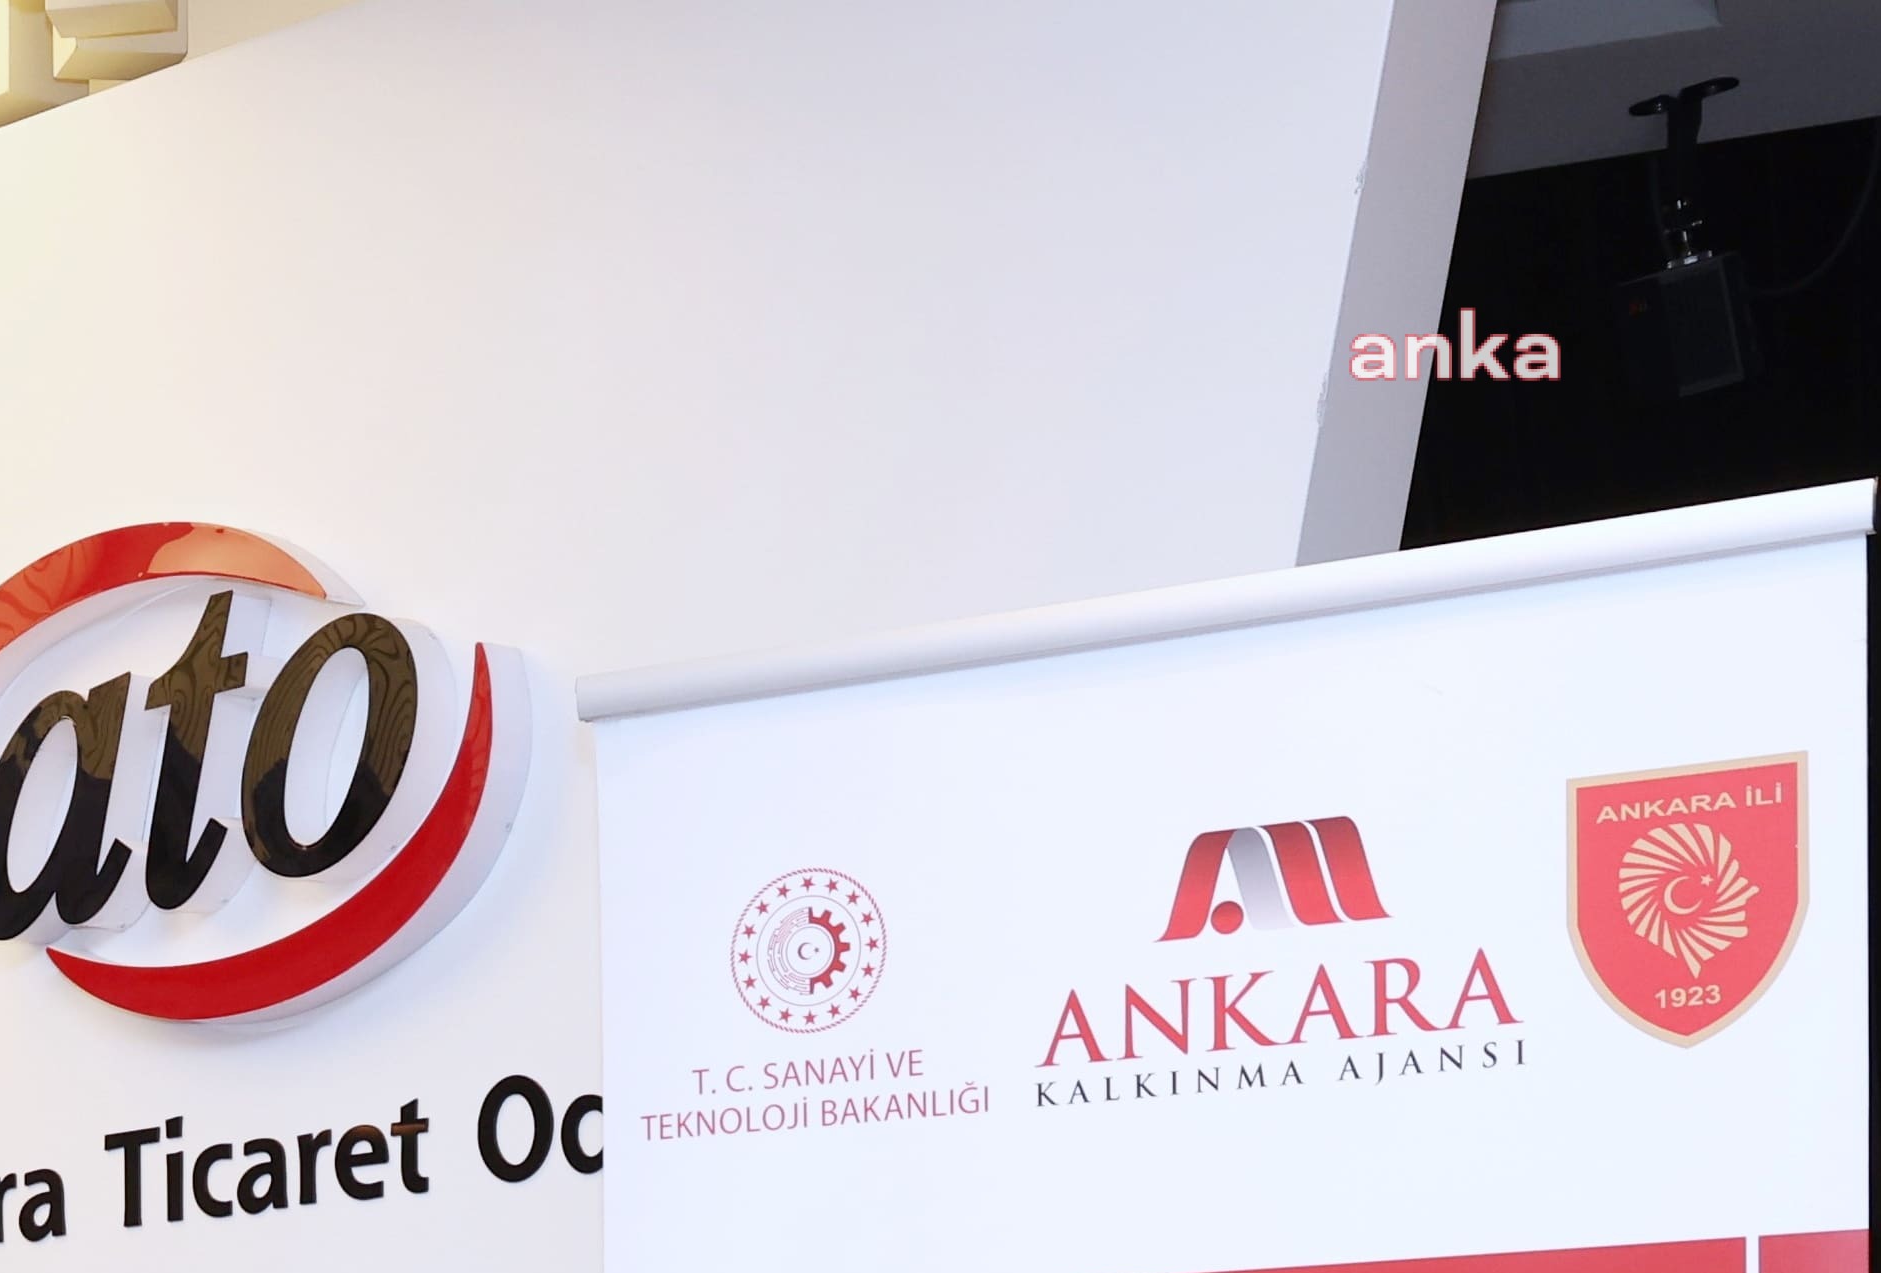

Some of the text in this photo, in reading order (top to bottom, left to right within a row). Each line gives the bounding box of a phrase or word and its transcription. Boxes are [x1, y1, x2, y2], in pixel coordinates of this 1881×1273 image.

[1596, 782, 1783, 824] ANKARA İLİ
[1036, 947, 1523, 1068] ANKARA
[1655, 985, 1720, 1008] 1923
[691, 1049, 925, 1094] T. C. SANAYİ VE
[1035, 1039, 1525, 1109] KALKINMA AJANSI
[640, 1097, 809, 1142] TEKNOLOJİ
[821, 1081, 990, 1127] BAKANLIĞI
[105, 1099, 429, 1228] Ticaret
